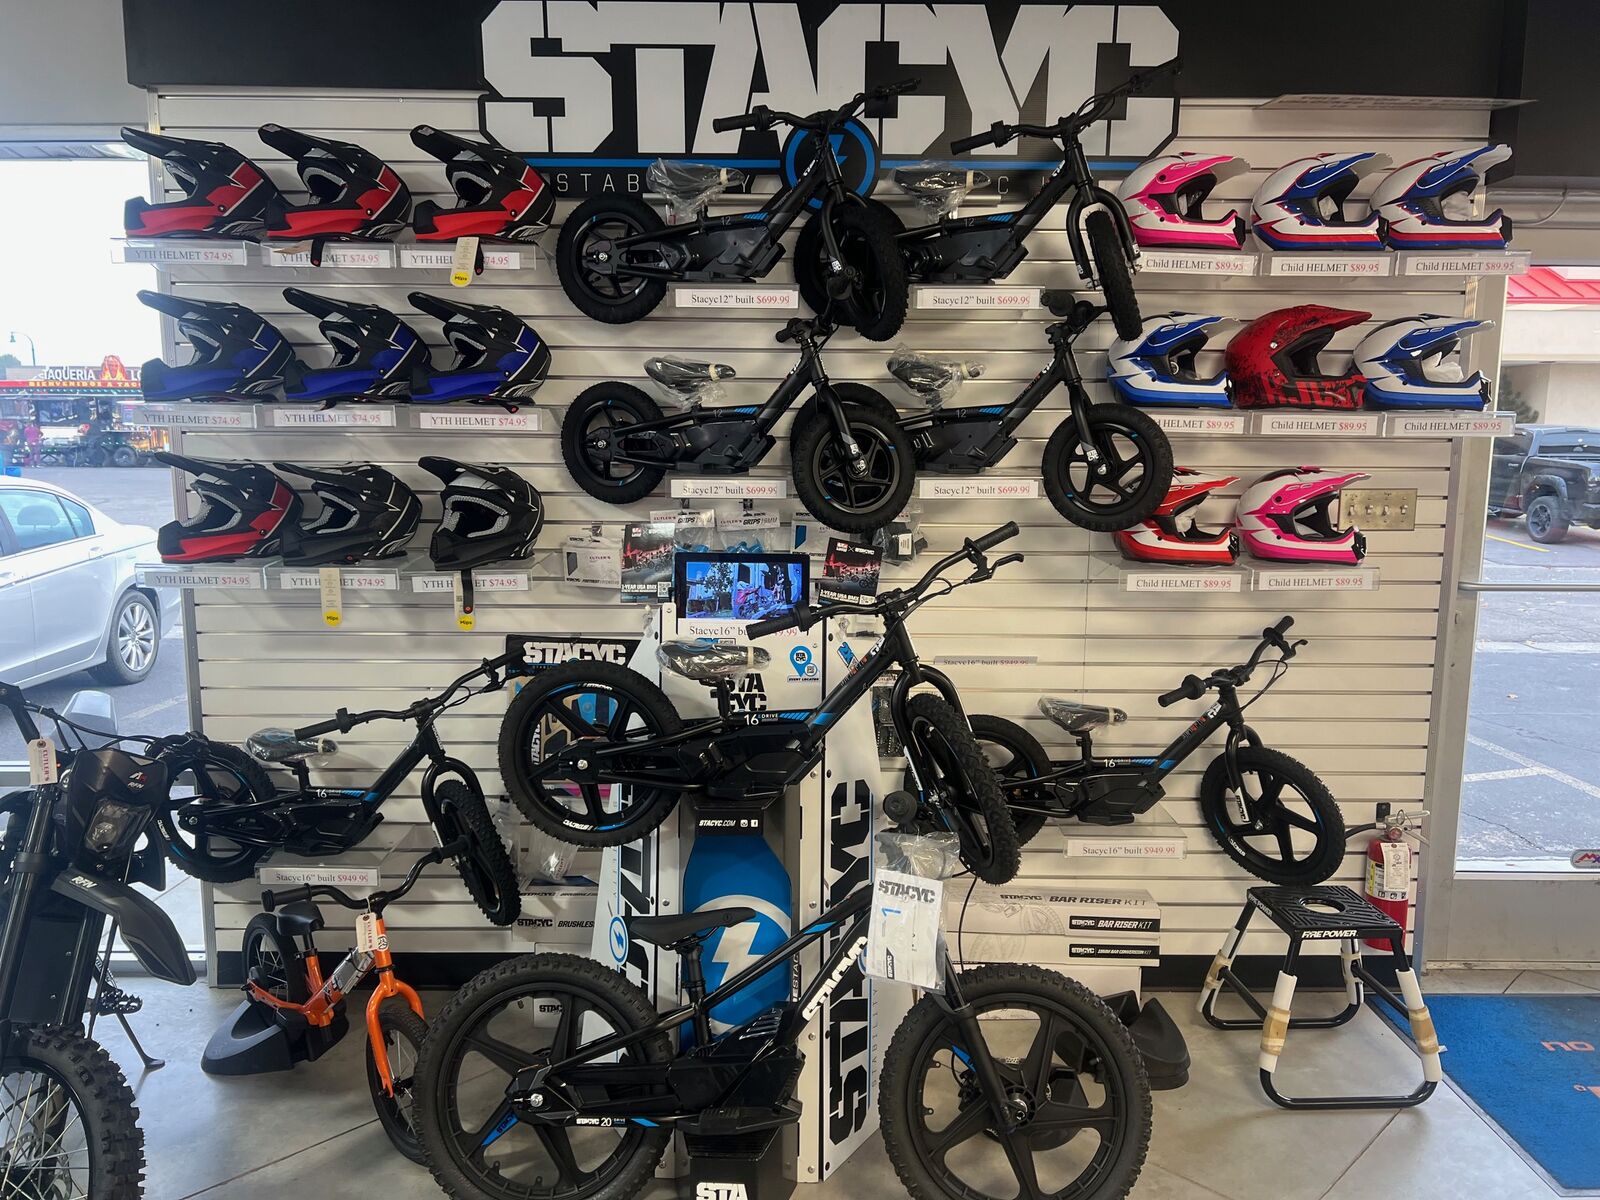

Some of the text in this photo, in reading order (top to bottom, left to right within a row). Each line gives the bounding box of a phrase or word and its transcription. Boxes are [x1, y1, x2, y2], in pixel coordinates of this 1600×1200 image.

[481, 1, 1180, 155] STACYC
[135, 251, 233, 262] YTH HELMET $74.95
[281, 253, 302, 263] YTH
[350, 254, 380, 263] $74.95
[412, 255, 433, 264] YTH
[1146, 259, 1244, 271] Child HELMET $89.95
[1281, 262, 1380, 272] Child HELMET $89.95
[1416, 261, 1514, 271] Child HELMET $89.95
[735, 295, 755, 304] built
[756, 295, 790, 305] $699.99
[976, 295, 996, 304] built
[997, 295, 1031, 305] $699.99
[143, 414, 241, 425] YTH HELMET $74.95
[284, 414, 381, 423] YTH HELMET $74.95
[431, 416, 527, 426] YTH HELMET $74.95
[1162, 419, 1204, 429] HELMET
[1205, 420, 1234, 430] $89.95
[1271, 421, 1367, 431] Child HELMET $89.95
[1404, 421, 1501, 431] Child HELMET $89.95
[725, 485, 744, 494] built
[746, 486, 778, 495] $699.99
[976, 485, 996, 495] built
[997, 486, 1031, 495] $699.99
[155, 575, 250, 585] YTH HELMET $74.95
[291, 577, 313, 586] YTH
[356, 577, 385, 587] $74.95
[423, 579, 444, 588] YTH
[489, 578, 517, 587] $74.95
[1136, 579, 1232, 588] Child HELMET $89.95
[1268, 578, 1363, 588] Child HELMET $89.95
[523, 642, 626, 665] STACYC
[743, 714, 759, 725] 16
[1103, 758, 1116, 768] 16
[316, 789, 327, 798] 16
[1123, 846, 1142, 855] built
[1144, 847, 1176, 855] $949.99
[71, 875, 98, 888] RFN
[317, 873, 336, 882] built
[337, 874, 369, 883] $949.99
[878, 880, 936, 904] STACYC
[1049, 895, 1078, 904] BAR
[1079, 896, 1122, 905] RISER
[1097, 920, 1114, 928] BAR
[1114, 921, 1138, 929] RISER
[1137, 921, 1152, 929] KIT
[601, 1117, 612, 1127] 20
